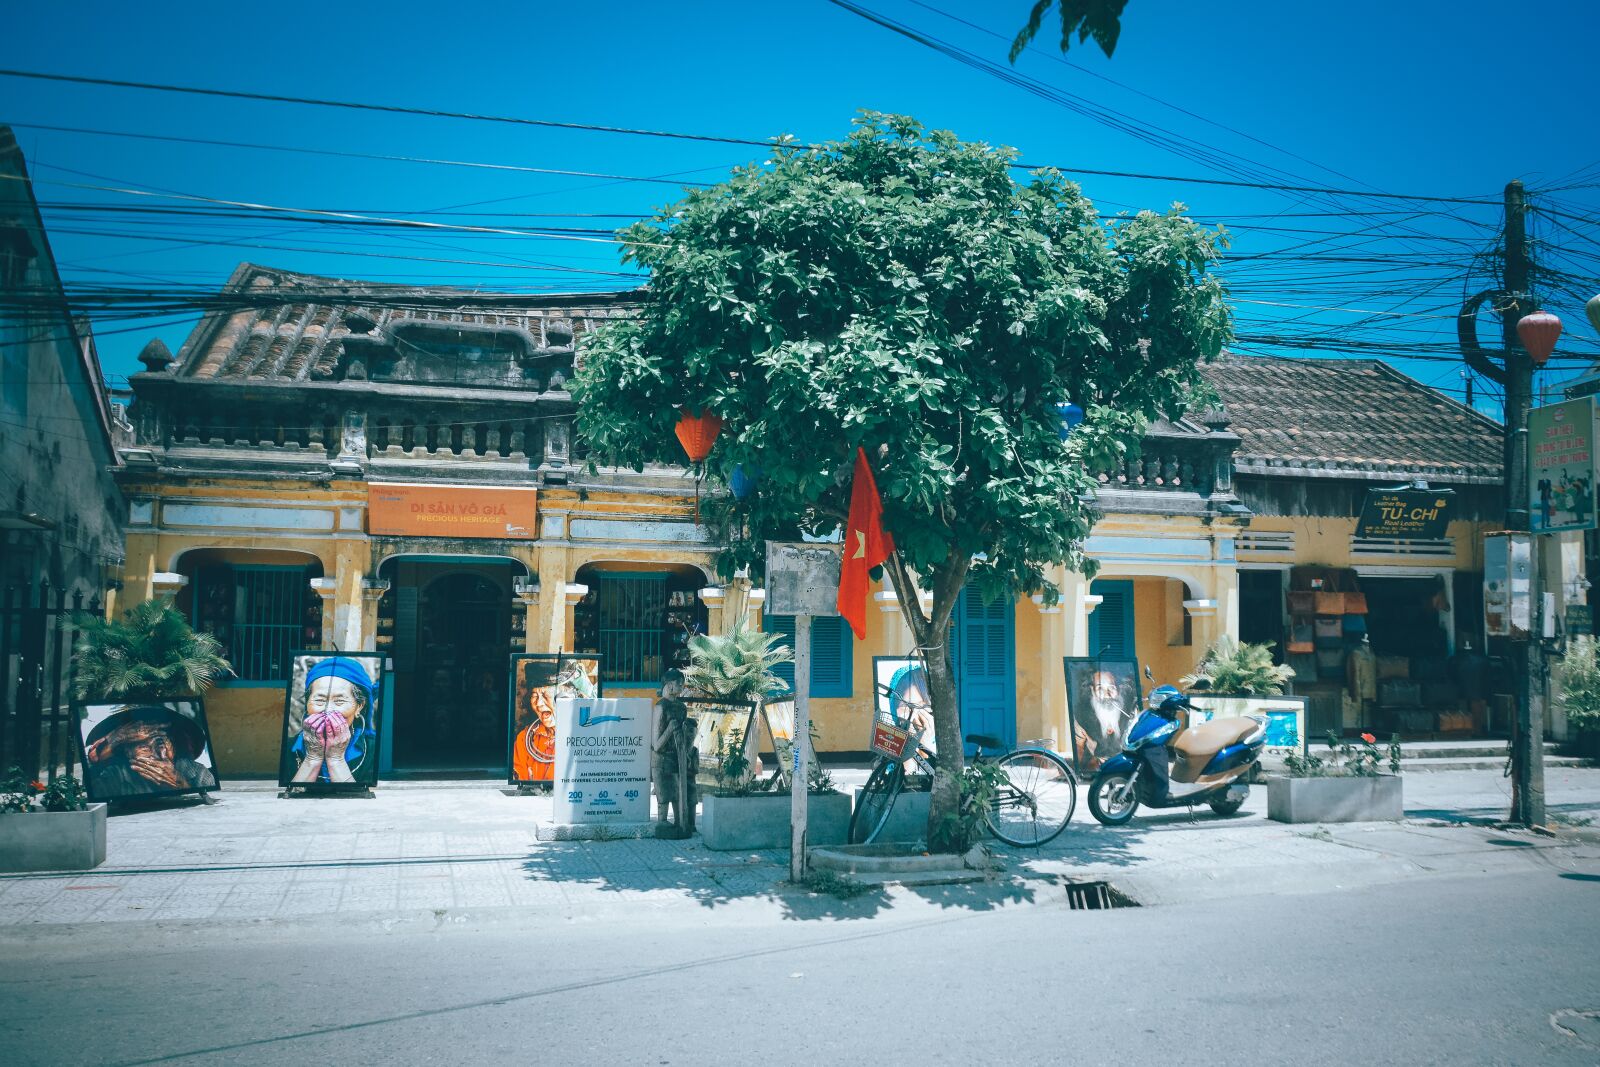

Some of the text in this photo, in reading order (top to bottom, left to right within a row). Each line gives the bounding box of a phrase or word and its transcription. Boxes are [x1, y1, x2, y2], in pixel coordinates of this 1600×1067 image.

[410, 503, 424, 513] DI
[458, 502, 479, 515] VÔ
[483, 503, 507, 516] GIÁ
[416, 514, 501, 524] PRECIOUS HERITAGE
[566, 736, 643, 747] PRECIOUS HERITAGE
[574, 749, 583, 757] ART
[583, 749, 608, 757] GALLERY
[568, 791, 583, 799] 200
[598, 790, 609, 798] 60
[624, 790, 639, 798] 450
